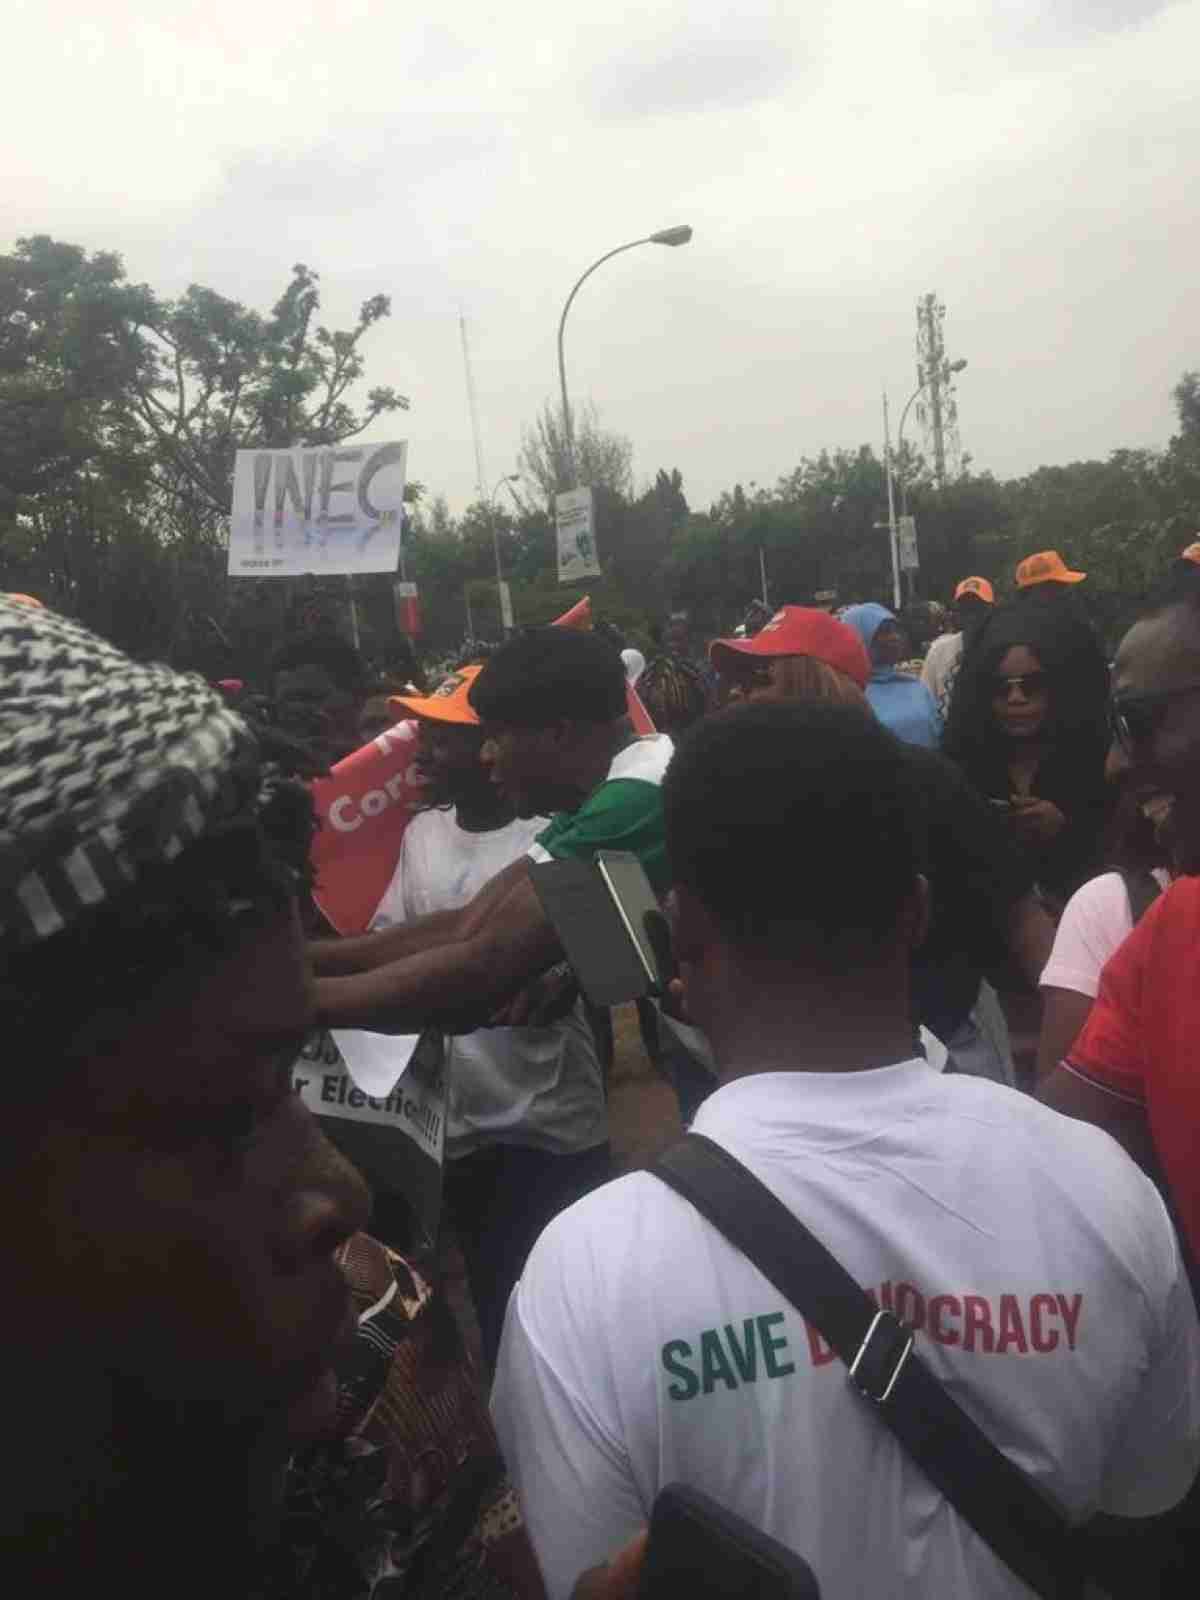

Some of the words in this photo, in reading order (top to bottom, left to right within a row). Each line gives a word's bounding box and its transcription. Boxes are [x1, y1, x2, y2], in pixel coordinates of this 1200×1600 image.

[254, 442, 401, 522] INEC
[661, 1311, 795, 1401] SAVE
[804, 1281, 1083, 1367] DOCRACY
